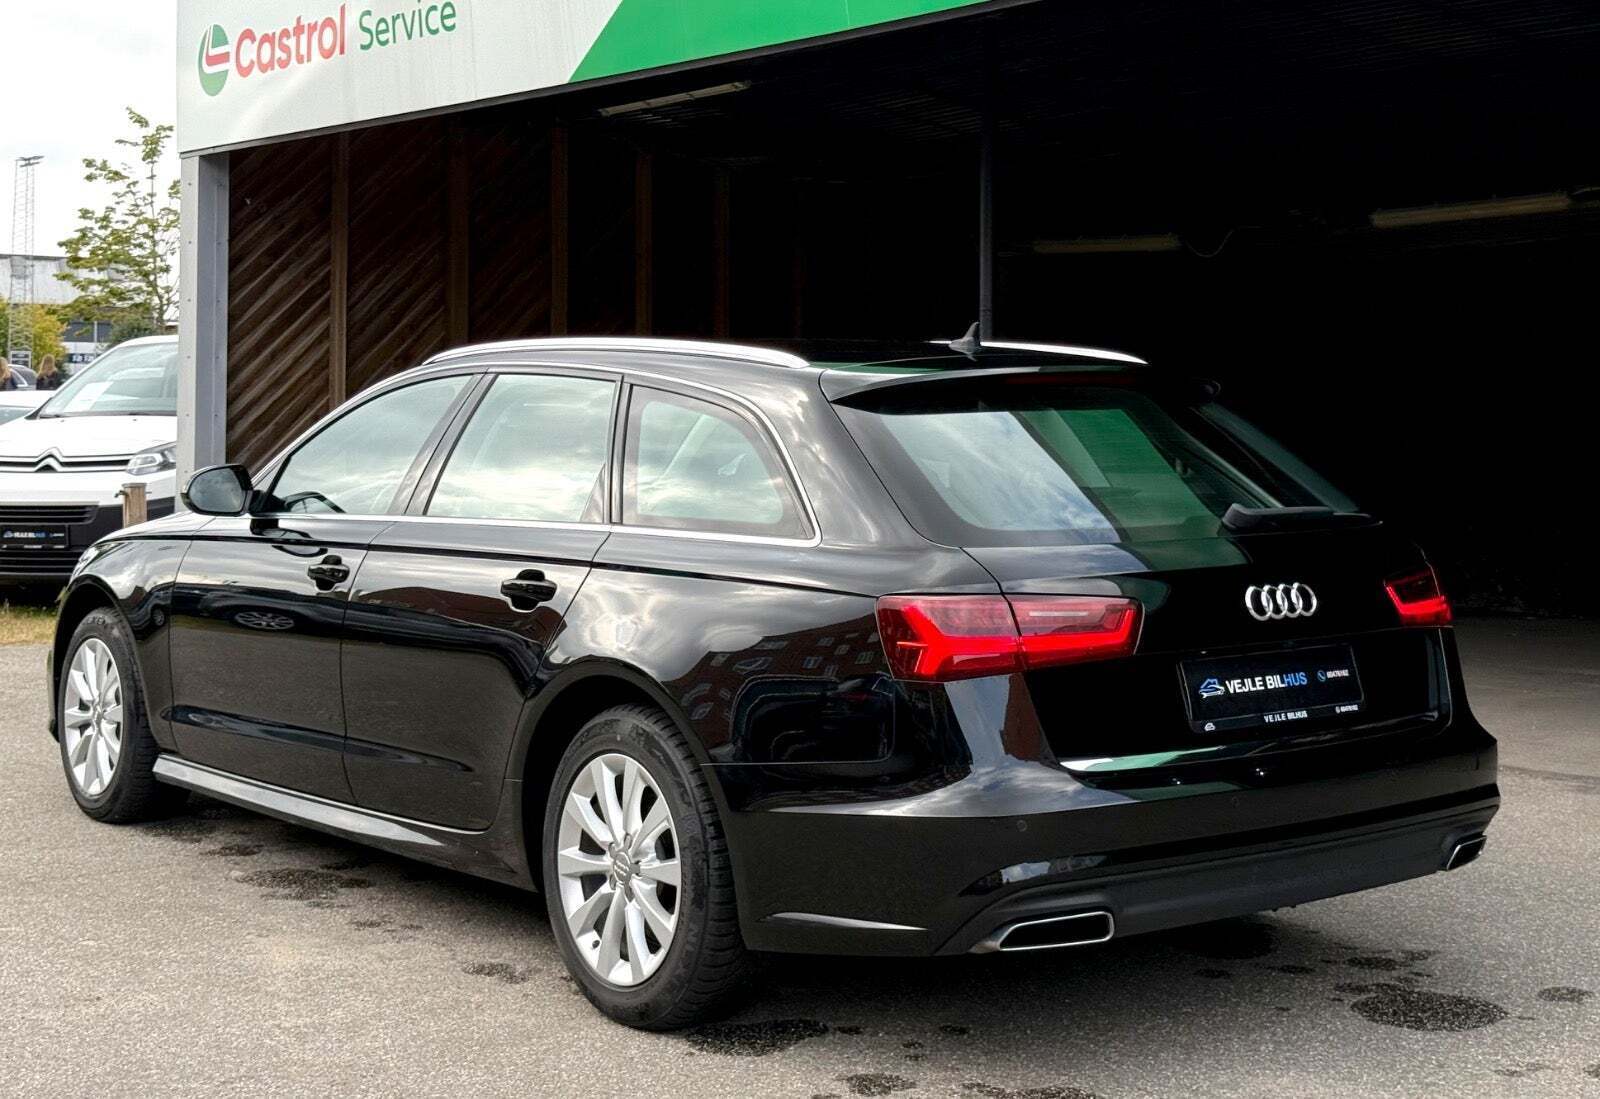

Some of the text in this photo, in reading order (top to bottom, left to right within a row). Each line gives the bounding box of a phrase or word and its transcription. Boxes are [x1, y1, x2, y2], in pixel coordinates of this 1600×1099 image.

[235, 0, 457, 78] Castrol Service
[1225, 672, 1308, 694] VEJLE BILHUS
[1263, 710, 1308, 723] VEJLE BILHUS
